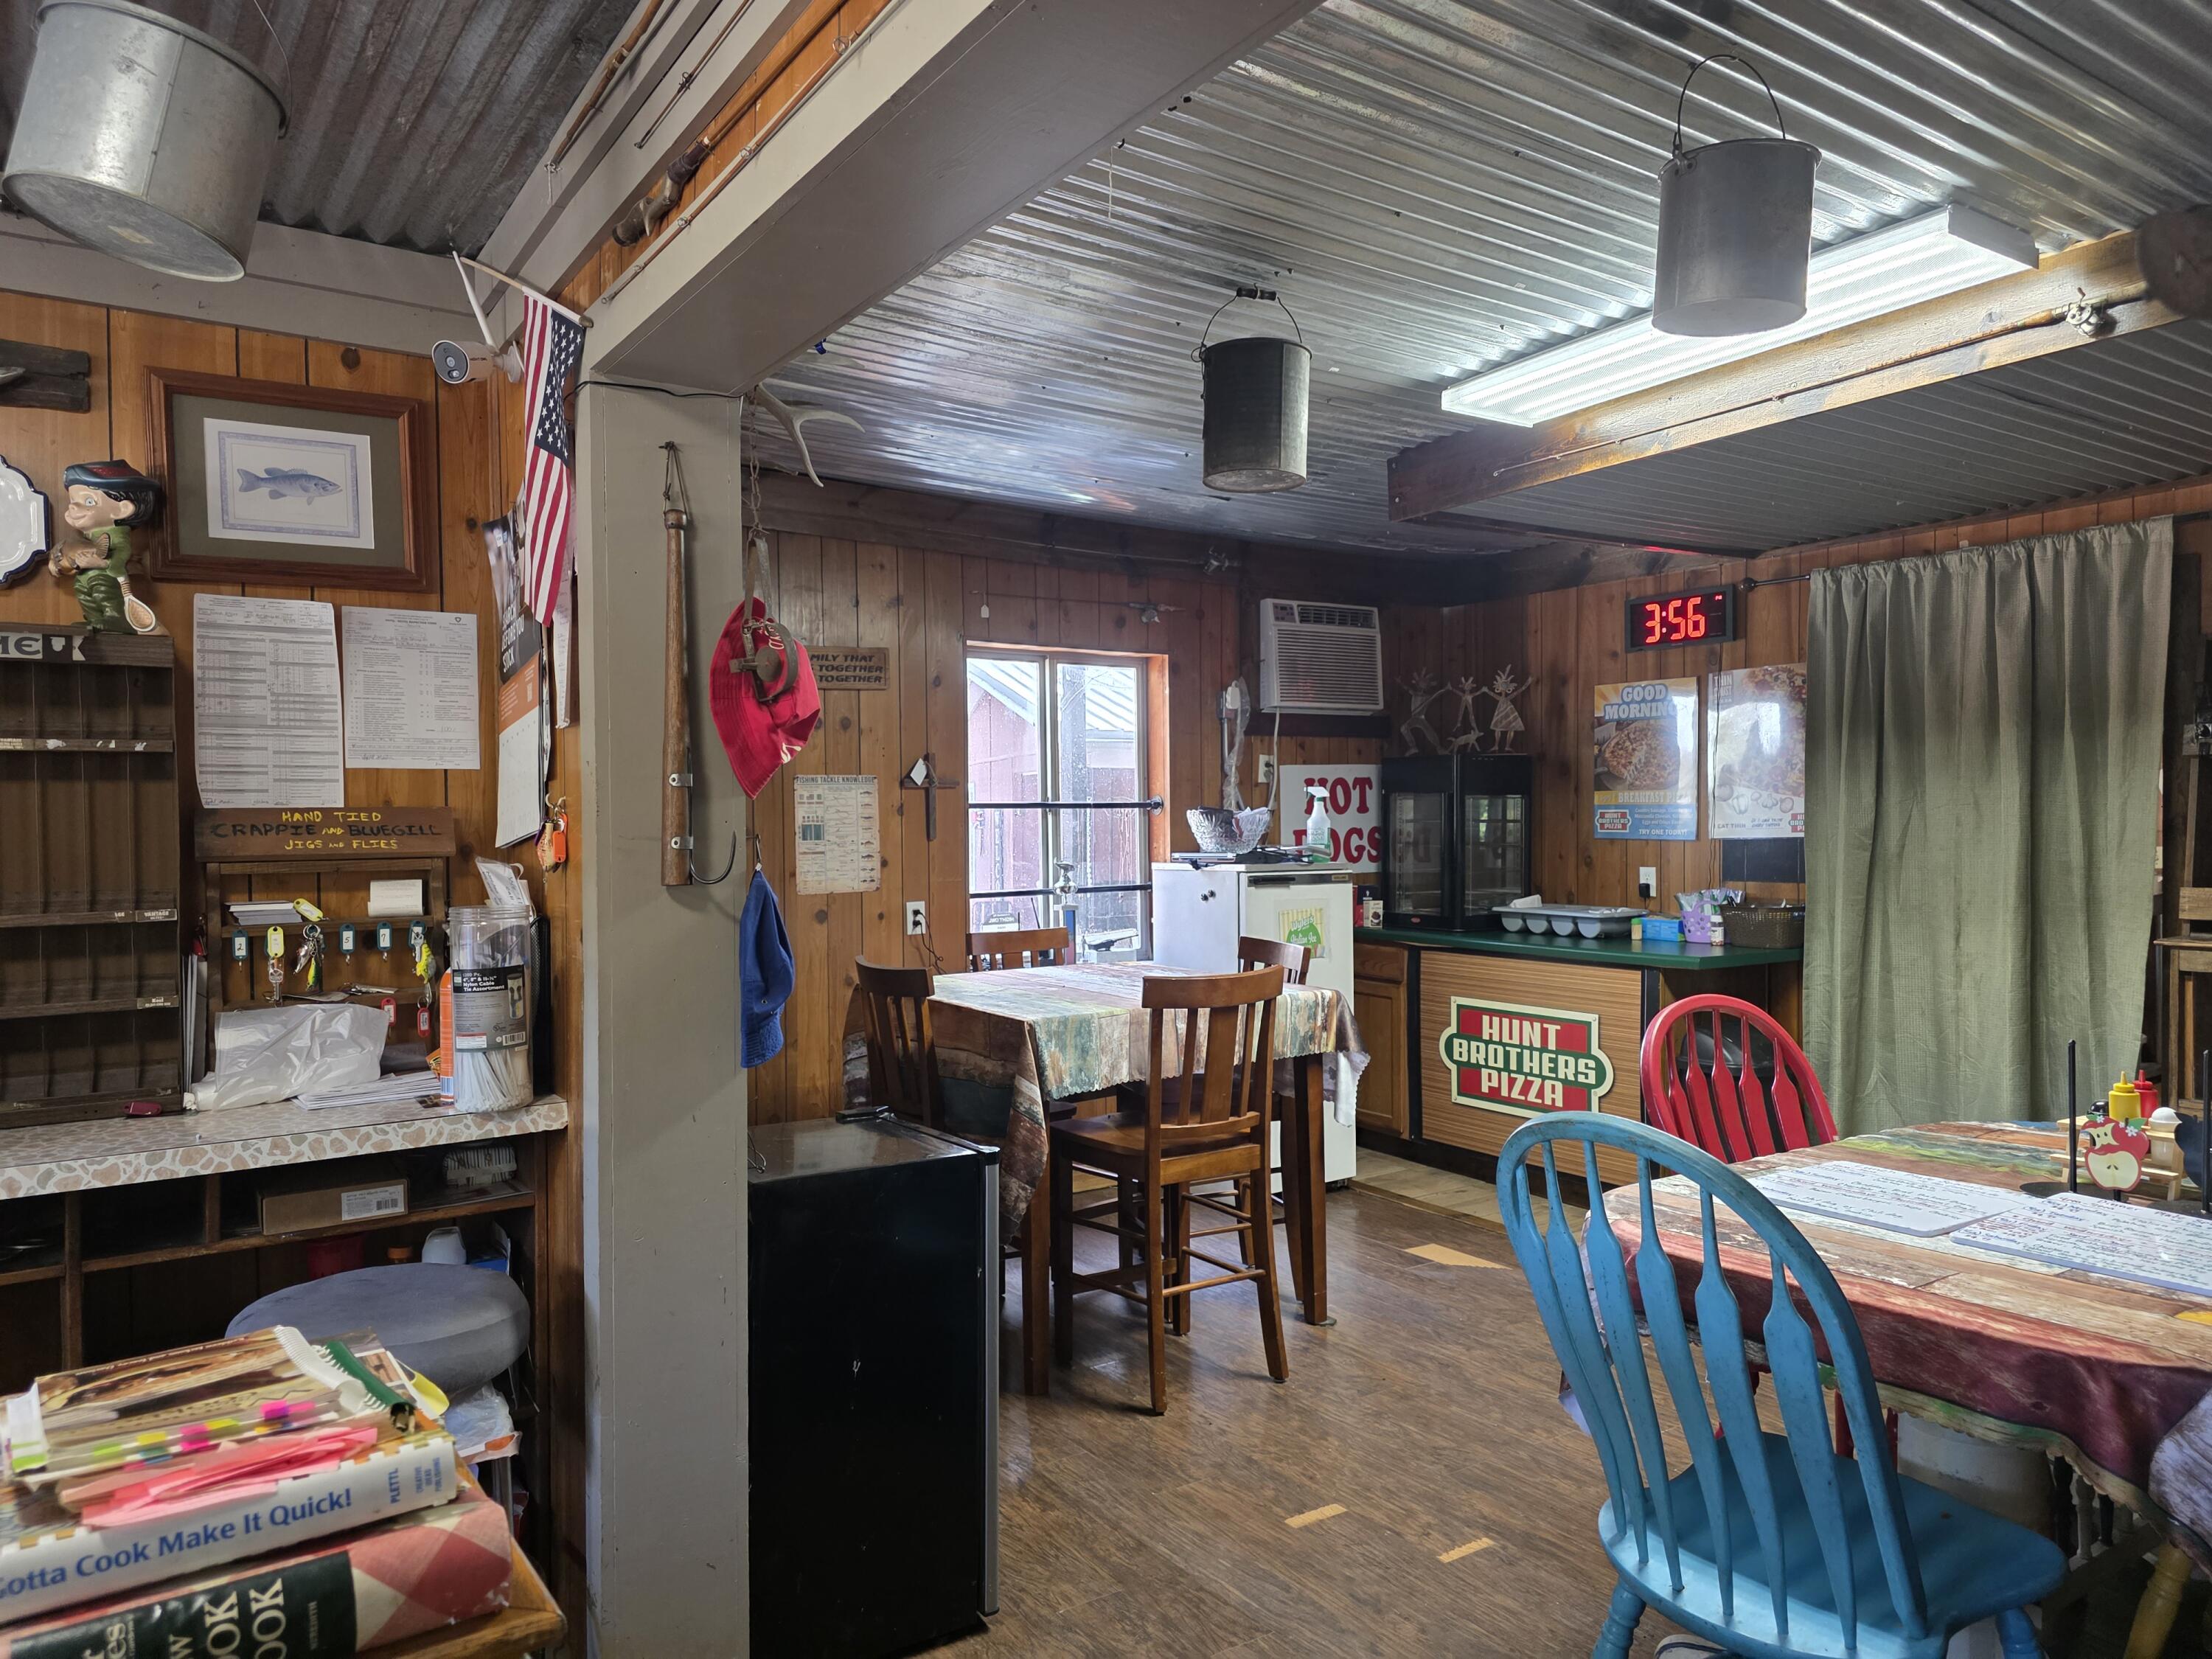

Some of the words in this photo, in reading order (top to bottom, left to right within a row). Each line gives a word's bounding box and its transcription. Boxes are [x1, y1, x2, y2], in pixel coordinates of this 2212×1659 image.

[1645, 597, 1705, 644] 3:56
[818, 664, 883, 672] TOGETHER
[818, 675, 883, 683] TOGETHER
[1622, 685, 1666, 702] GOOD
[1618, 793, 1664, 803] BREAKFAST
[282, 811, 322, 822] HAND
[334, 812, 381, 822] TIED
[212, 823, 316, 838] CRAPPIE
[348, 824, 441, 836] BLUEGILL
[285, 839, 323, 849] JIGS
[352, 838, 397, 849] FLIES
[1292, 914, 1314, 931] Wyler's
[1482, 1015, 1561, 1051] HUNT
[1453, 1037, 1596, 1085] BROTHERS
[1481, 1068, 1563, 1107] PIZZA
[2096, 1199, 2143, 1211] Dinner
[1980, 1234, 2024, 1244] Saturday
[76, 1542, 150, 1576] Cook
[158, 1523, 235, 1557] Make
[244, 1512, 262, 1534] It
[270, 1488, 352, 1526] Quick!
[203, 1590, 241, 1659] OK
[248, 1577, 288, 1659] OOK
